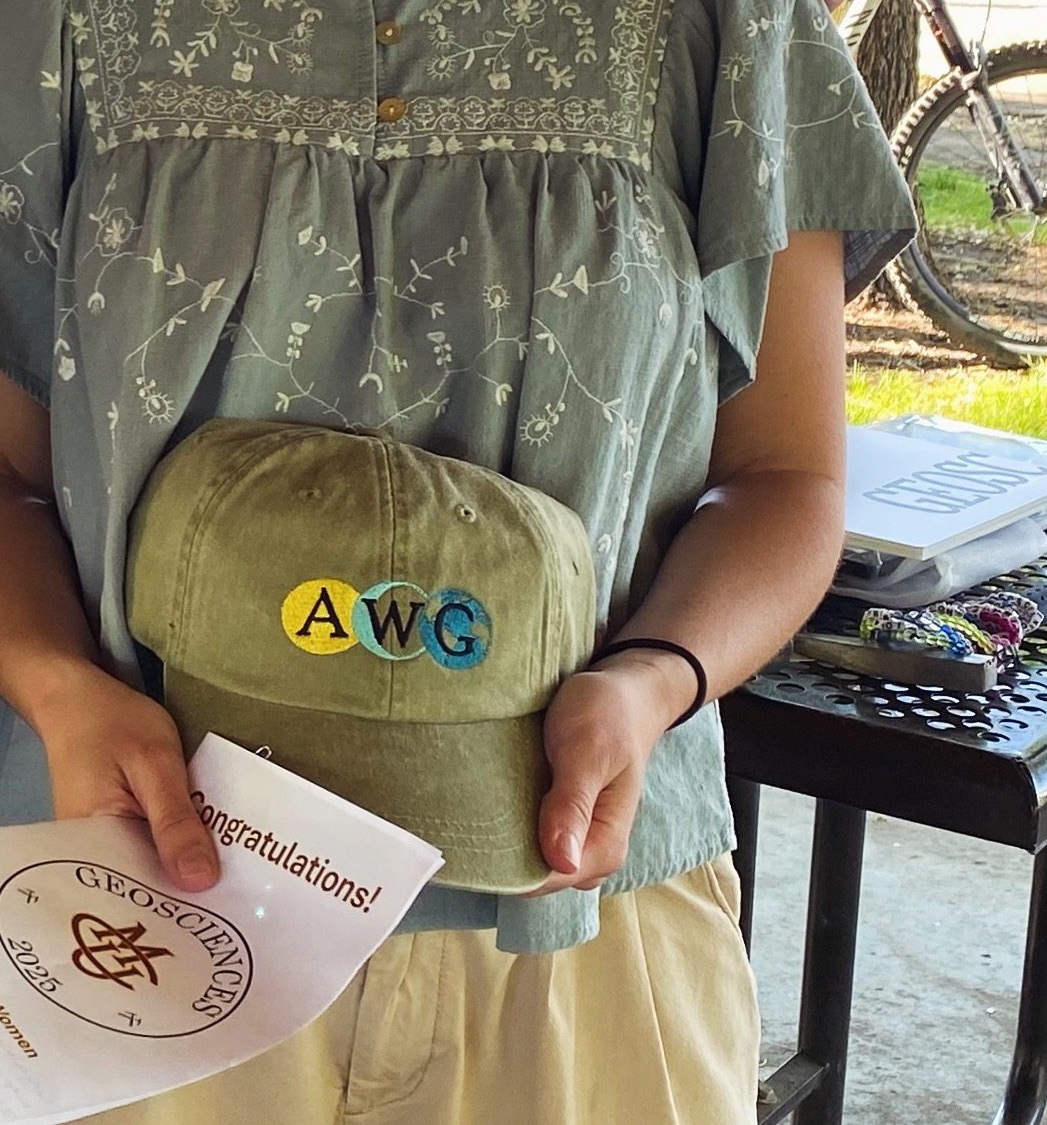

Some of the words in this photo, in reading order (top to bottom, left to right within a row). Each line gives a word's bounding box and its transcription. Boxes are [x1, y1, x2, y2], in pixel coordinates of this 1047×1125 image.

[295, 587, 476, 657] AWG
[7, 937, 64, 993] 2025
[75, 866, 244, 1019] GEOSCIENCES
